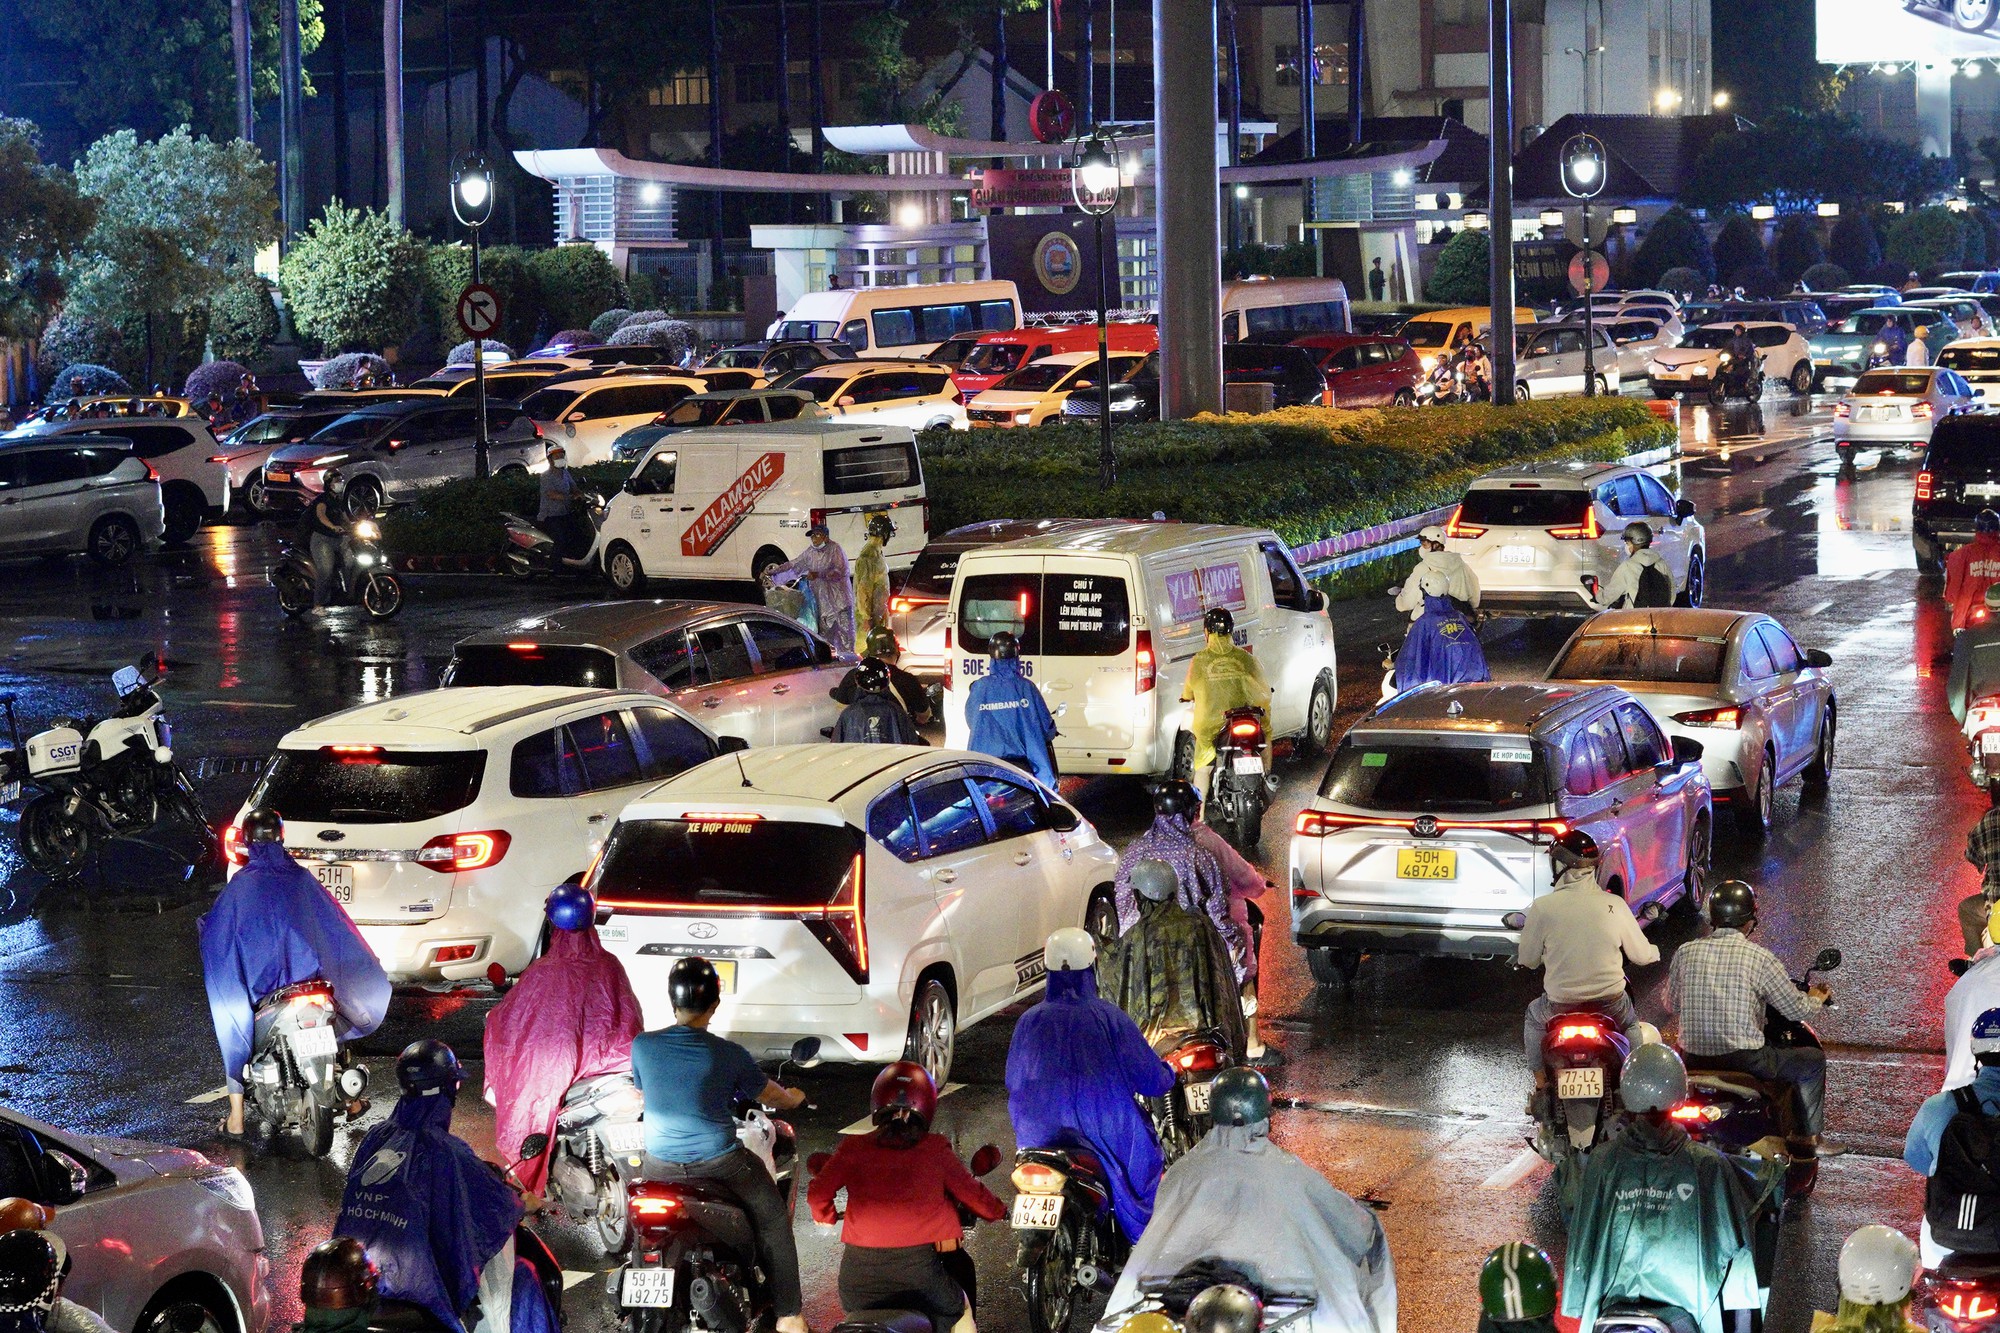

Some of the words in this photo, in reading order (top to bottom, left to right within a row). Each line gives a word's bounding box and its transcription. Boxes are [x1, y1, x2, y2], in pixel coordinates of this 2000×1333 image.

[695, 455, 773, 542] LALAMOVE
[1073, 578, 1087, 589] CHÚ
[1089, 578, 1093, 590] Ý
[1180, 566, 1241, 600] LALAMOVE
[1091, 593, 1102, 602] APP
[1092, 622, 1102, 631] APP
[687, 822, 701, 833] XE
[702, 822, 722, 835] HỢP
[724, 820, 752, 833] ĐỒNG
[1414, 851, 1439, 864] 50H
[318, 868, 342, 883] 51H
[1404, 865, 1449, 878] 487.49
[1566, 1071, 1596, 1083] 77-L2
[1562, 1084, 1600, 1096] 087.15
[355, 1191, 390, 1202] VNP
[1023, 1198, 1055, 1211] 47-AB
[1014, 1213, 1057, 1226] 094.40
[632, 1272, 666, 1286] 59-PA
[629, 1289, 669, 1304] 192.75
